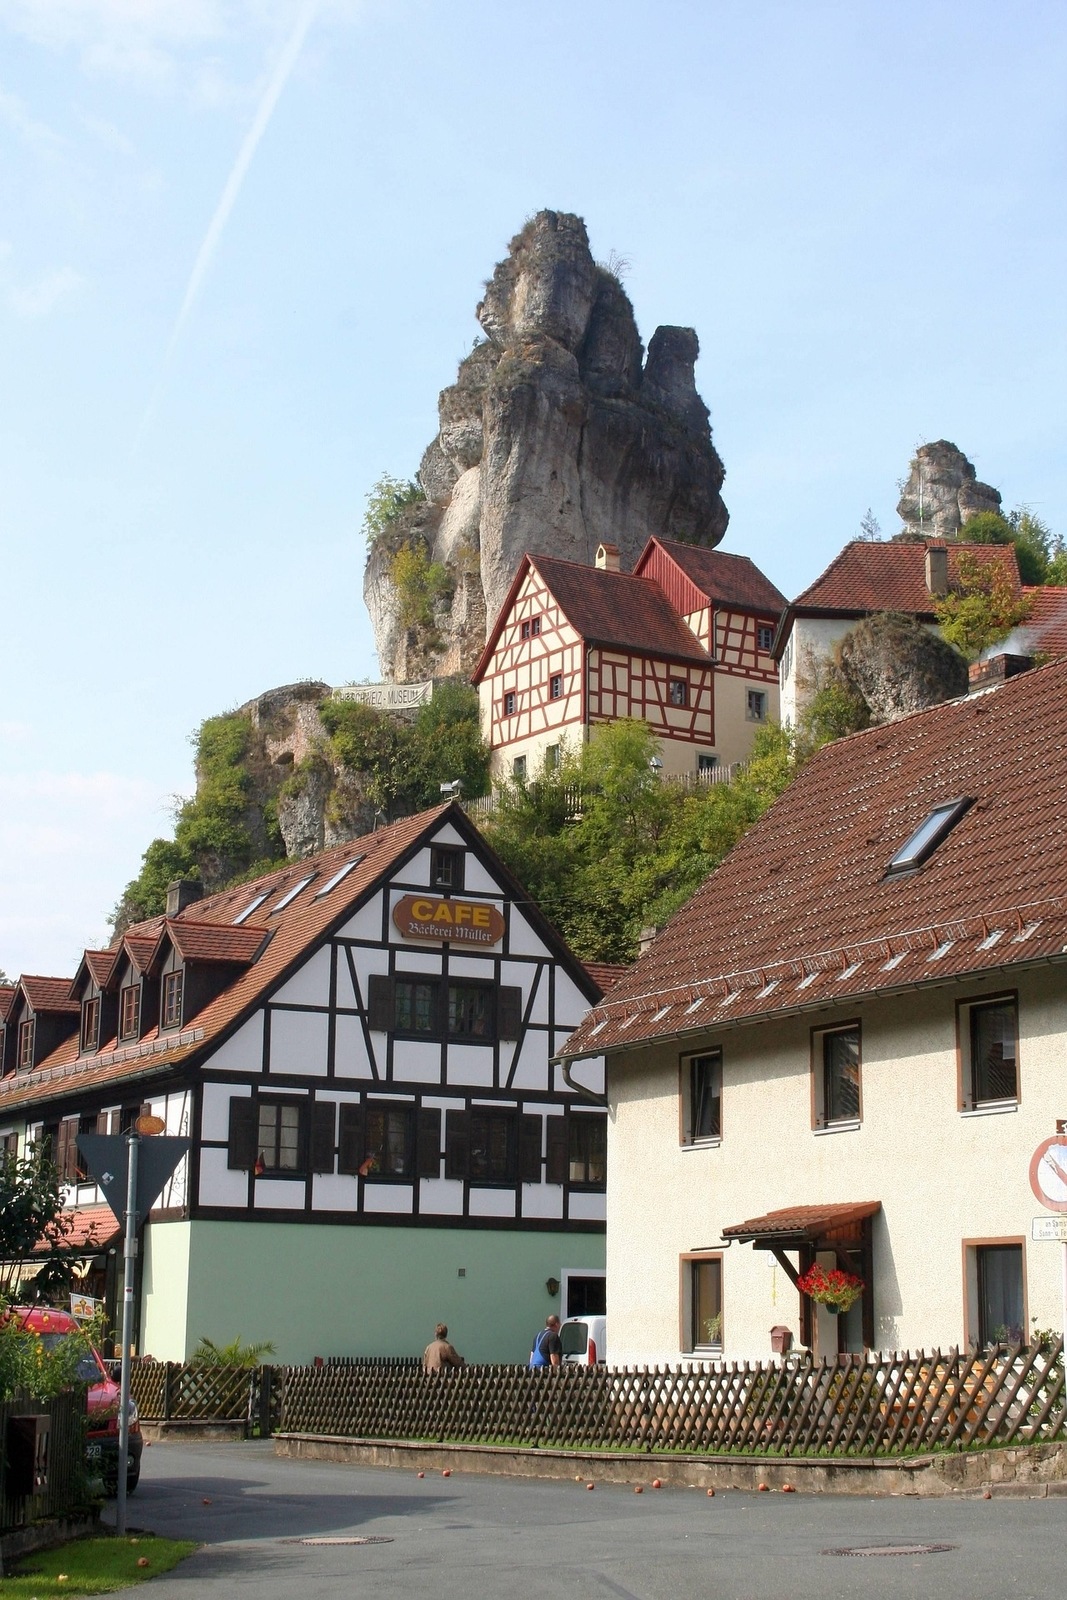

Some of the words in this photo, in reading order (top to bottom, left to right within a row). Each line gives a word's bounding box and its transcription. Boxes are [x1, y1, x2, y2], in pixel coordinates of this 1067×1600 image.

[411, 901, 490, 927] CAFE
[408, 923, 452, 937] Bäckerei
[455, 927, 492, 941] Müller
